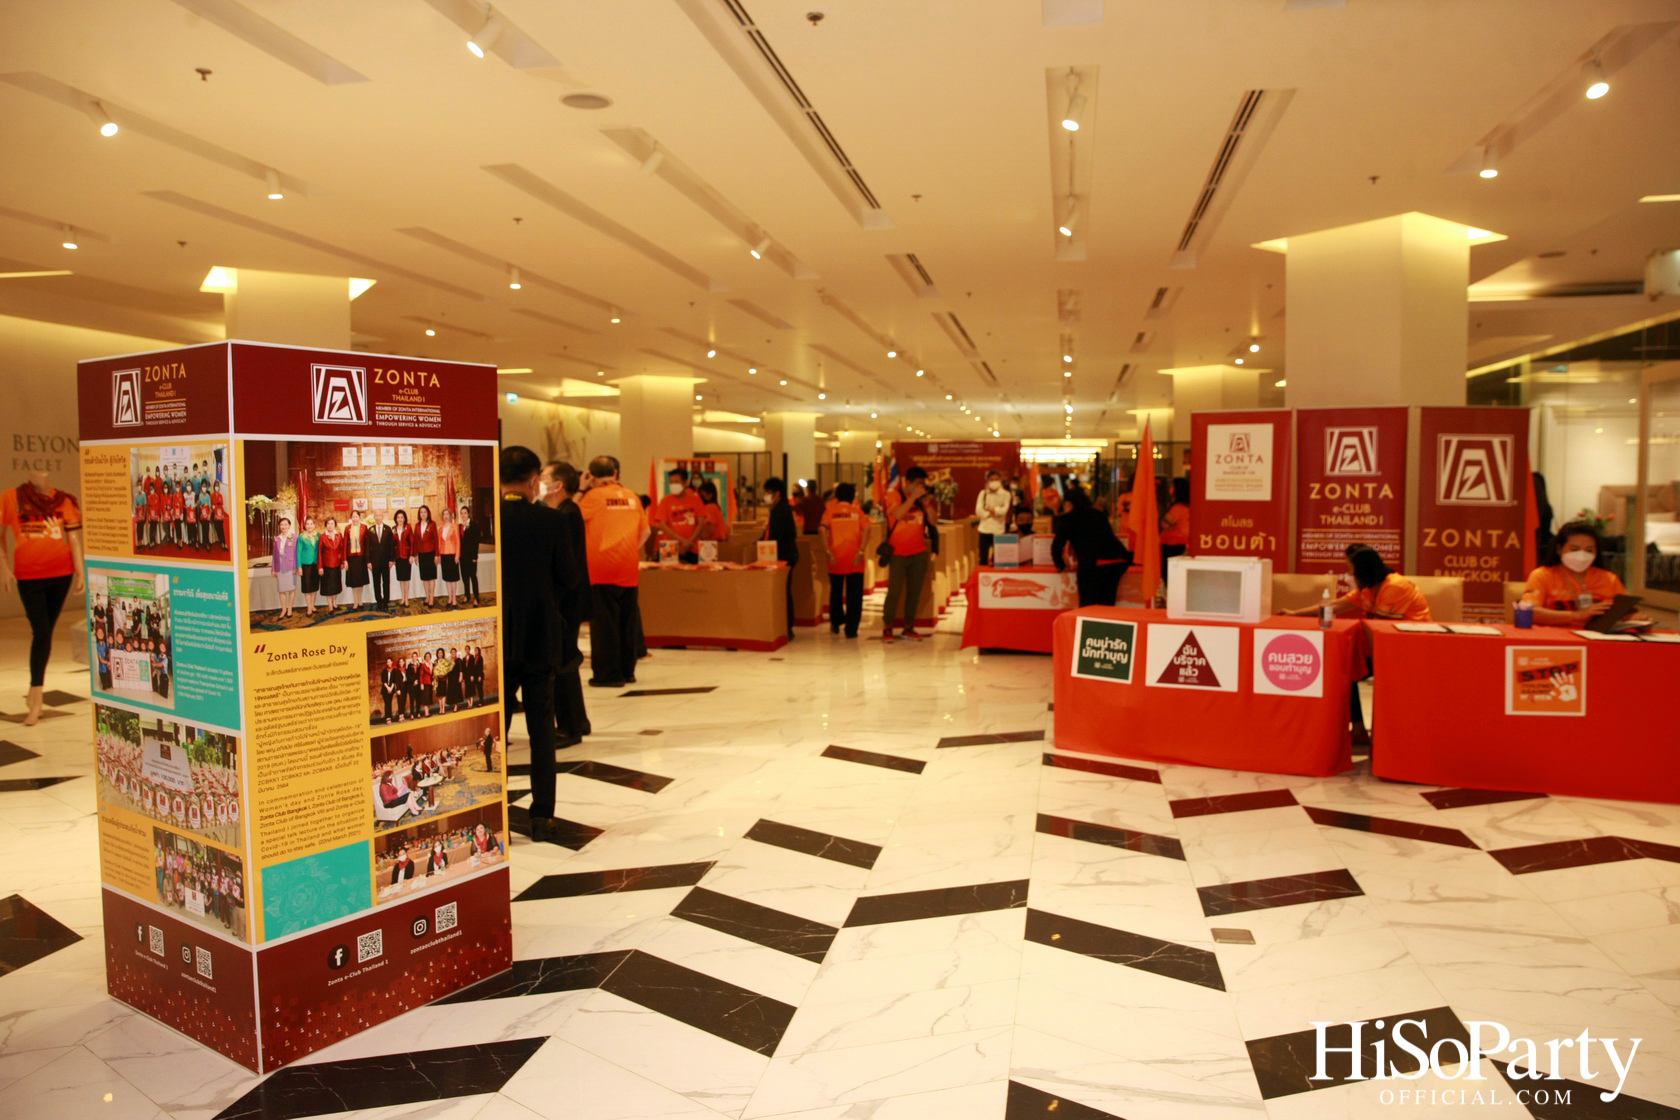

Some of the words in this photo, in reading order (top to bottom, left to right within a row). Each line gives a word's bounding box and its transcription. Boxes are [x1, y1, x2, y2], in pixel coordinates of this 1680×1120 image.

[145, 362, 186, 382] ZONTA
[374, 368, 440, 388] ZONTA
[392, 394, 422, 402] THAILAND
[376, 414, 416, 422] EMPOWERING
[12, 459, 63, 472] FACET
[1215, 454, 1264, 464] ZONTA
[1310, 483, 1394, 500] ZONTA
[1332, 504, 1371, 514] e-CLUB
[1221, 515, 1253, 528] สโมสร
[1320, 515, 1378, 525] THAILAND
[1200, 532, 1276, 551] ซอนต้า
[1423, 528, 1520, 549] ZONTA
[1444, 555, 1478, 568] CLUB
[1480, 556, 1500, 568] OF
[1086, 636, 1126, 651] คนน่ารัก
[1182, 645, 1197, 656] ฉัน
[267, 652, 298, 662] Zonta
[302, 648, 326, 658] Rose
[329, 645, 347, 655] Day
[1082, 646, 1128, 664] มักทำบุญ
[1173, 654, 1206, 666] บริจาค
[1268, 651, 1313, 664] คนสวย
[1179, 667, 1198, 677] แล้ว
[1269, 664, 1312, 675] ชอบทำบุญ
[1521, 664, 1578, 681] STOP
[266, 790, 312, 803] commemoration
[326, 780, 356, 790] celebration
[260, 827, 285, 836] Thailand
[290, 821, 308, 830] joined
[310, 816, 332, 824] together
[341, 808, 364, 816] organize
[294, 811, 315, 820] Bangkok
[265, 834, 285, 843] special
[336, 816, 358, 825] situation
[260, 841, 288, 852] Covid-19
[296, 833, 320, 842] Thailand
[261, 851, 278, 859] should
[410, 930, 463, 955] zontaeclubthailand1
[328, 976, 343, 986] Zonta
[345, 969, 361, 980] e-Club
[362, 961, 385, 973] Thailand
